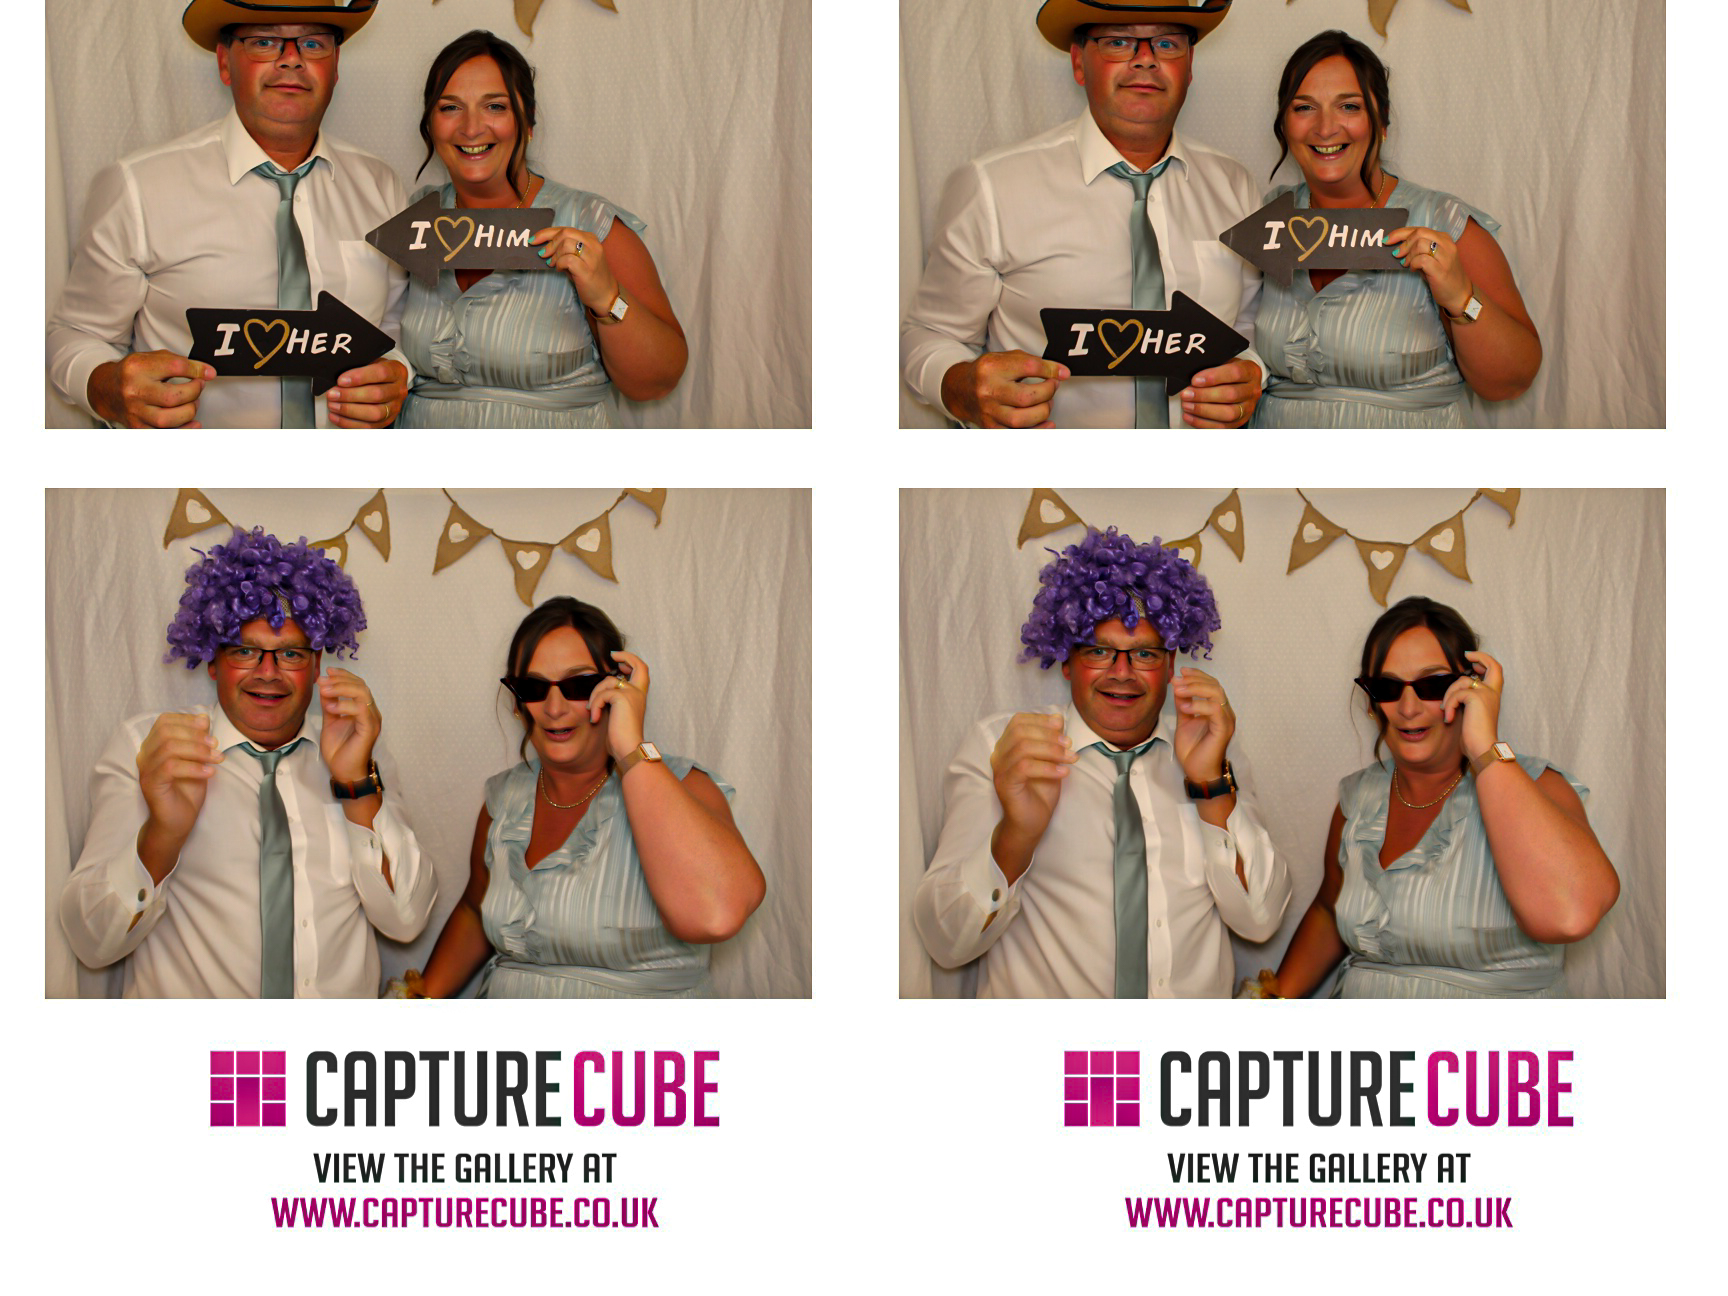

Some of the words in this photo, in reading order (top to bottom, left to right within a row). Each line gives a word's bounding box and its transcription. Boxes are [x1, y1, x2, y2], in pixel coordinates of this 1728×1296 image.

[408, 220, 431, 250] I
[474, 224, 530, 247] HIM
[1262, 220, 1285, 250] I
[1328, 224, 1384, 247] HIM
[213, 323, 241, 357] I
[285, 328, 353, 355] HER
[1067, 323, 1095, 357] I
[1139, 328, 1207, 355] HER
